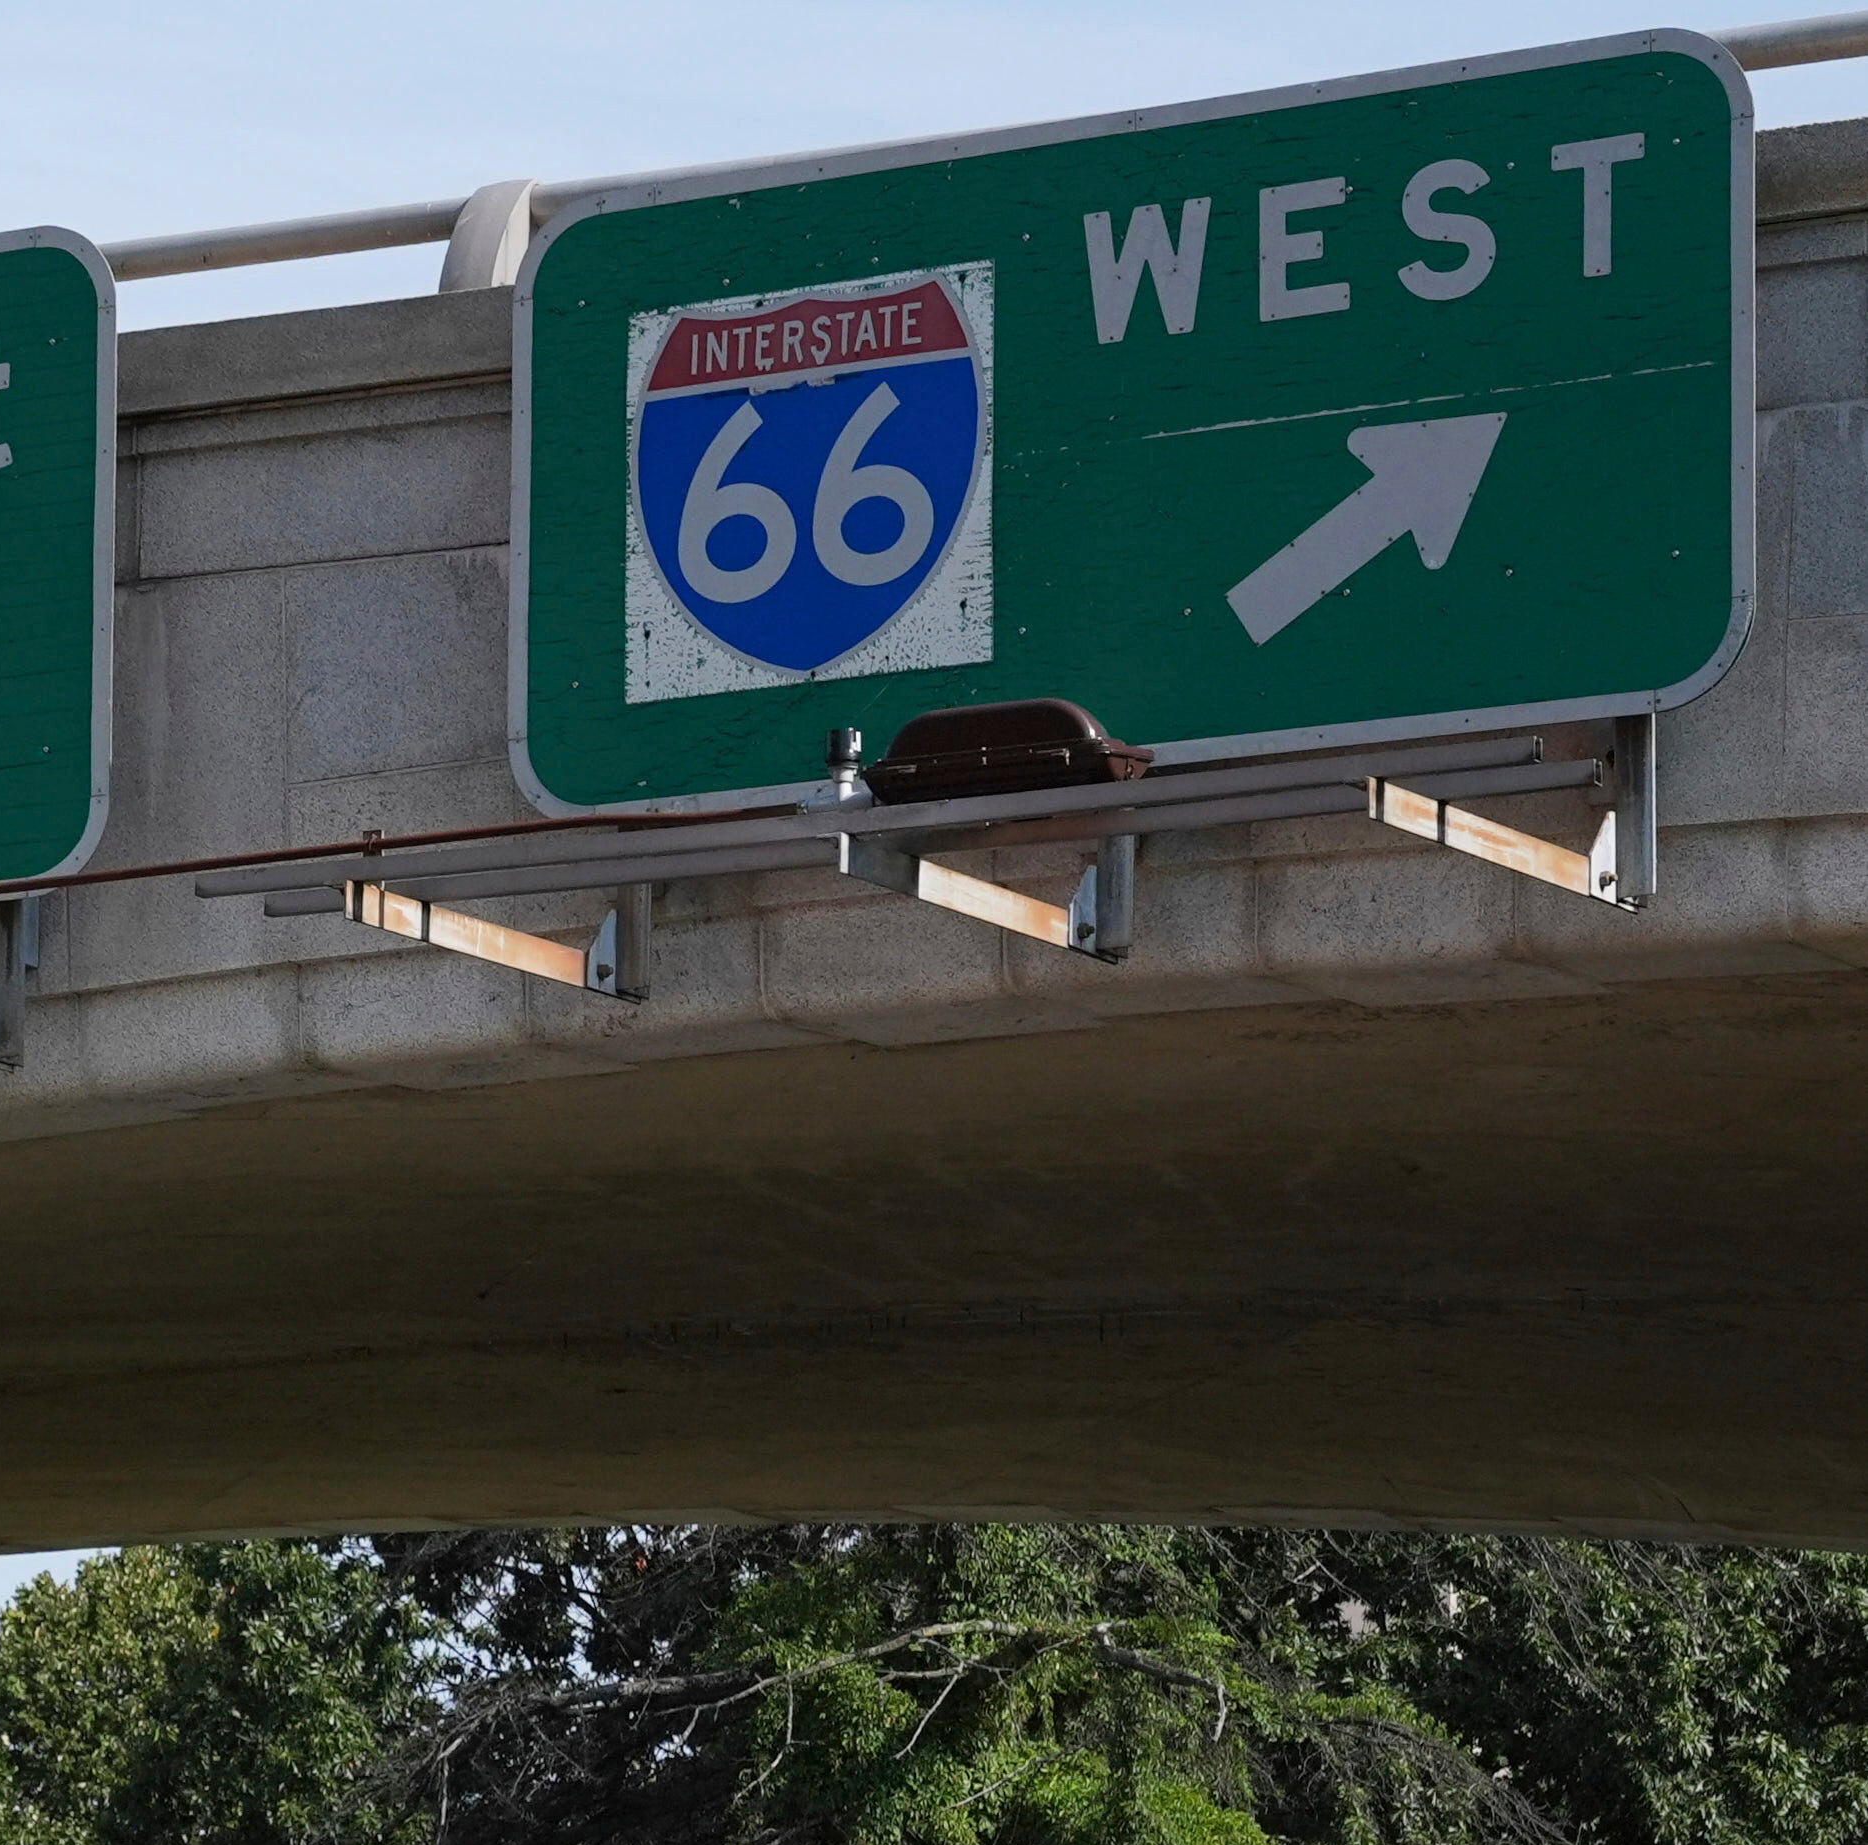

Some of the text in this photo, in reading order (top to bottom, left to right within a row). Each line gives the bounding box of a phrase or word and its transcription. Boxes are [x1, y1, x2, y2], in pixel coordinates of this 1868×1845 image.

[689, 302, 922, 376] INTERSTATE
[1083, 132, 1646, 344] WEST
[676, 381, 935, 603] 66
